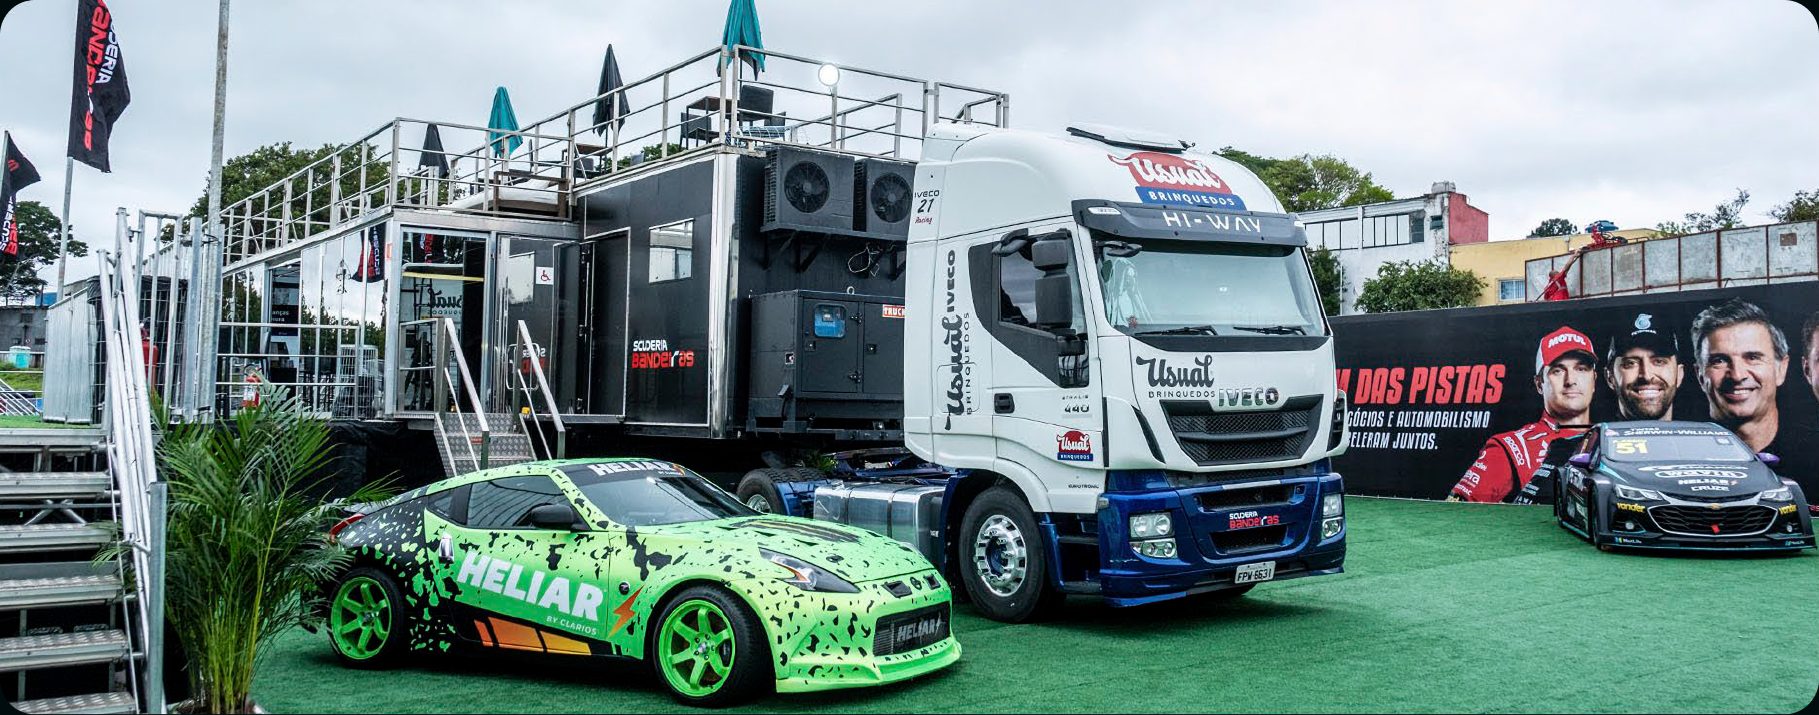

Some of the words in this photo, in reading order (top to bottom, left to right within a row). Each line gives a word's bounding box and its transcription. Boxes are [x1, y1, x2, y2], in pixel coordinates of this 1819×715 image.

[1112, 156, 1221, 189] Usual
[914, 189, 940, 198] IVECO
[1148, 190, 1236, 206] BRINQUEDOS
[917, 198, 935, 213] 21
[915, 216, 933, 225] Racing
[946, 249, 956, 313] IVECO
[632, 339, 668, 351] SCUDERIA
[1548, 333, 1586, 348] MOTUL
[941, 314, 965, 431] Usual
[963, 312, 973, 415] BRINQUEDOS
[1135, 354, 1215, 388] Usual
[1354, 367, 1406, 405] DAS
[1408, 364, 1506, 405] PISTAS
[1148, 390, 1216, 399] BRINQUEDOS
[1218, 387, 1280, 407] IVECO
[1064, 404, 1090, 413] 440
[1348, 408, 1385, 427] GÓCIOS
[1387, 411, 1395, 427] E
[1396, 410, 1491, 428] AUTOMOBILISMO
[1056, 433, 1090, 451] Usual
[1348, 431, 1389, 448] ELERAM
[1392, 433, 1438, 450] JUNTOS.
[1616, 441, 1648, 454] 51
[587, 461, 675, 476] HELIAR
[1229, 511, 1259, 520] SCUDERIA
[456, 550, 604, 622] HELIAR
[546, 615, 558, 624] BY
[559, 618, 597, 636] CLARIOS
[896, 618, 935, 642] HELIAR
